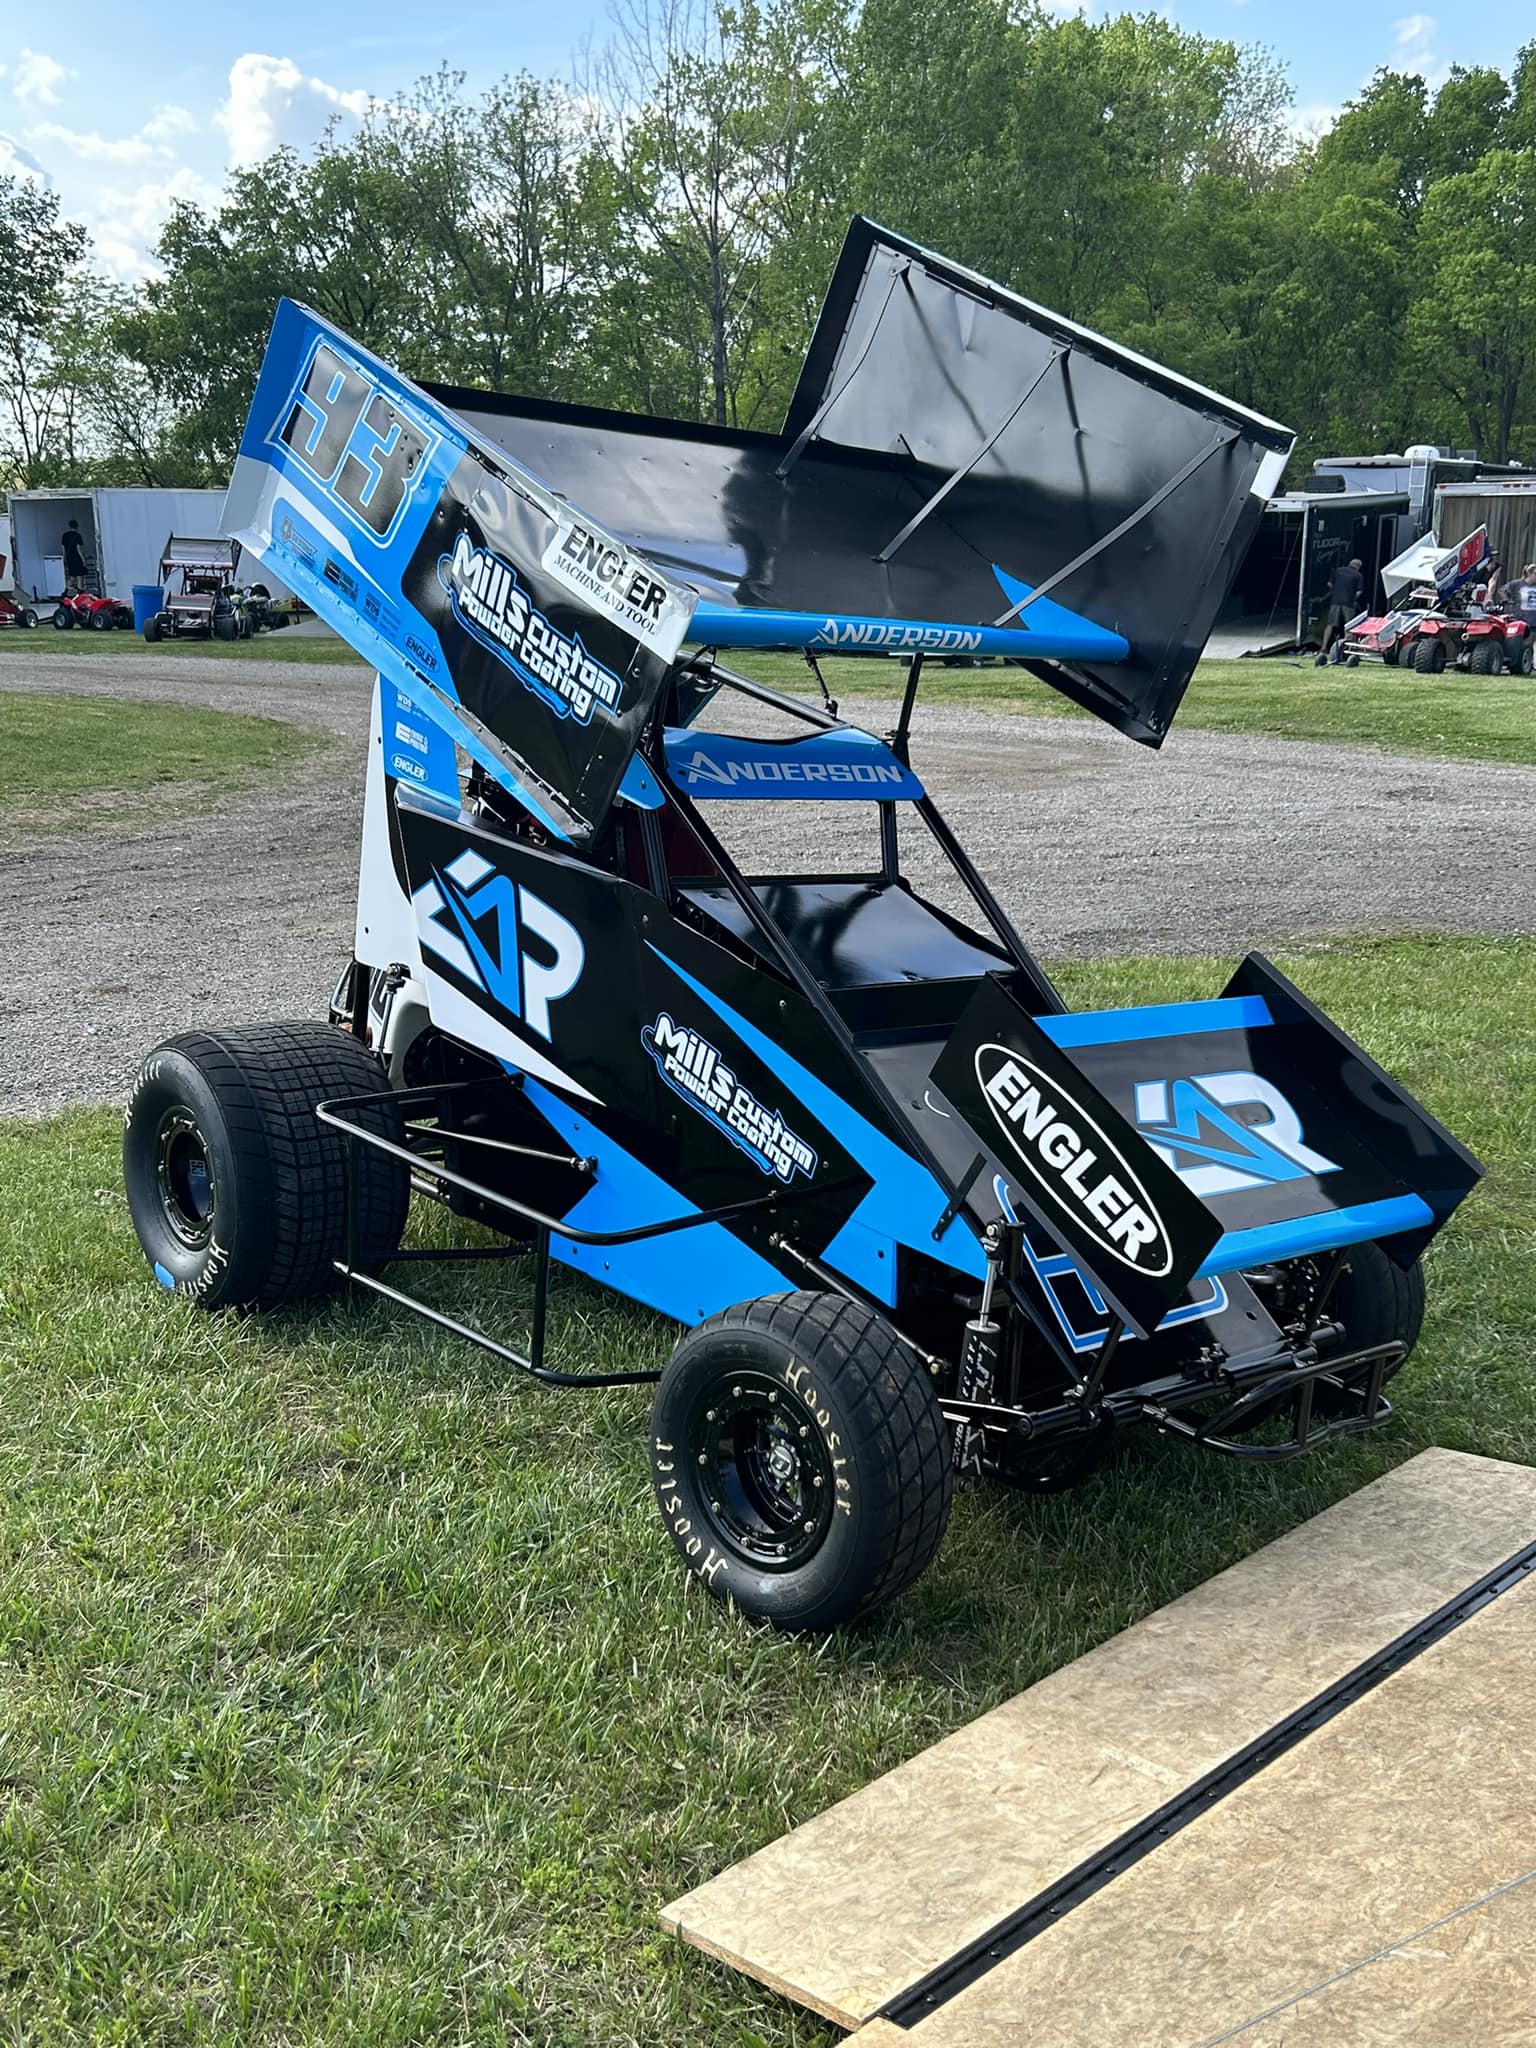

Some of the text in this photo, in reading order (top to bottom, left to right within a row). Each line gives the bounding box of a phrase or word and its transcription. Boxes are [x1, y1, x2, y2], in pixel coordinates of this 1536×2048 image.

[452, 538, 528, 633] Mills
[554, 555, 657, 636] MACHINE AND TOOL
[561, 525, 668, 620] ENGLER
[459, 585, 521, 650] Powder
[809, 619, 983, 650] ANDERSON
[405, 635, 438, 671] ENGLER
[394, 756, 426, 781] ENGLER
[685, 752, 902, 784] ANDERSON
[654, 1016, 735, 1101] Mills
[664, 1053, 728, 1113] Powder
[985, 1060, 1159, 1262] ENGLER
